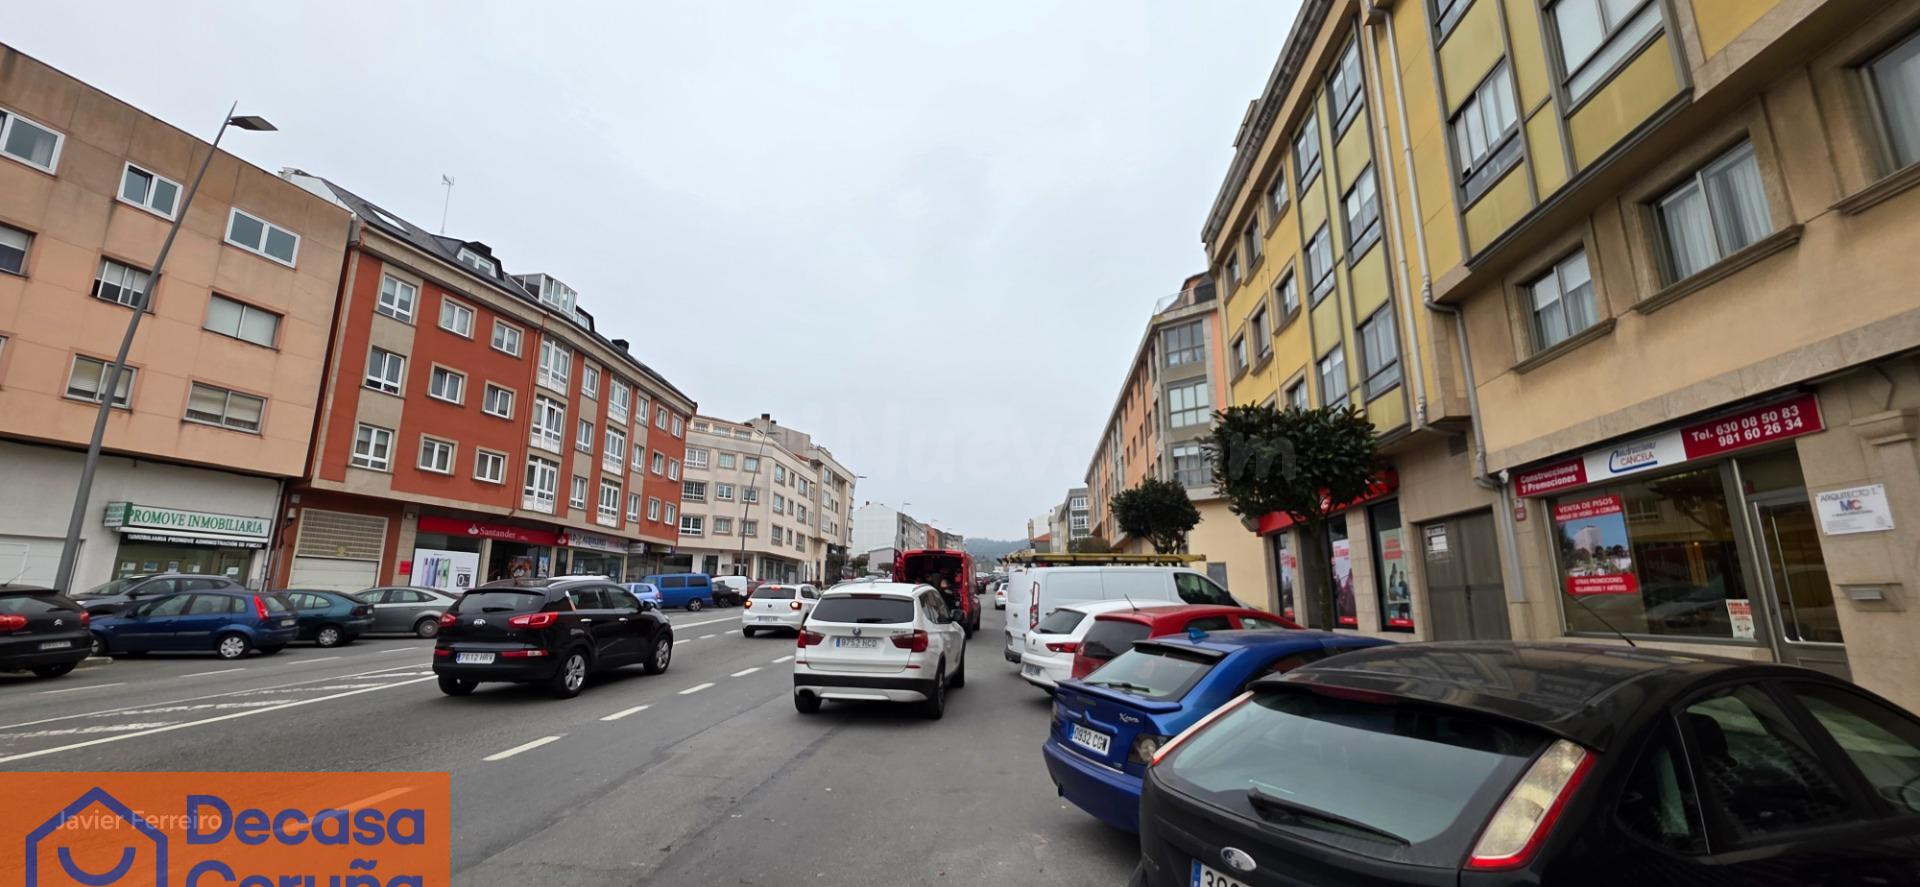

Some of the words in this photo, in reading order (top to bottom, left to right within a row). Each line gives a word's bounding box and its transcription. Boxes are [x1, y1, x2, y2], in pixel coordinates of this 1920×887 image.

[1691, 429, 1714, 441] Tel.
[1715, 421, 1738, 436] 630
[1741, 416, 1758, 429] 08
[1761, 411, 1778, 423] 50
[1781, 405, 1799, 418] 83
[1718, 432, 1740, 447] 981
[1744, 427, 1760, 440] 60
[1764, 422, 1781, 436] 26
[1784, 416, 1803, 431] 34
[1620, 452, 1654, 466] CANCELA
[1520, 463, 1578, 483] Construcciones
[1528, 474, 1576, 491] Promociones
[1559, 503, 1580, 513] VENTA
[1581, 501, 1591, 509] DE
[1592, 497, 1613, 506] PISOS
[129, 510, 185, 527] PROMOVE
[187, 515, 263, 534] INMOBILIARIA
[479, 526, 516, 539] Santander
[1074, 727, 1092, 745] 0932
